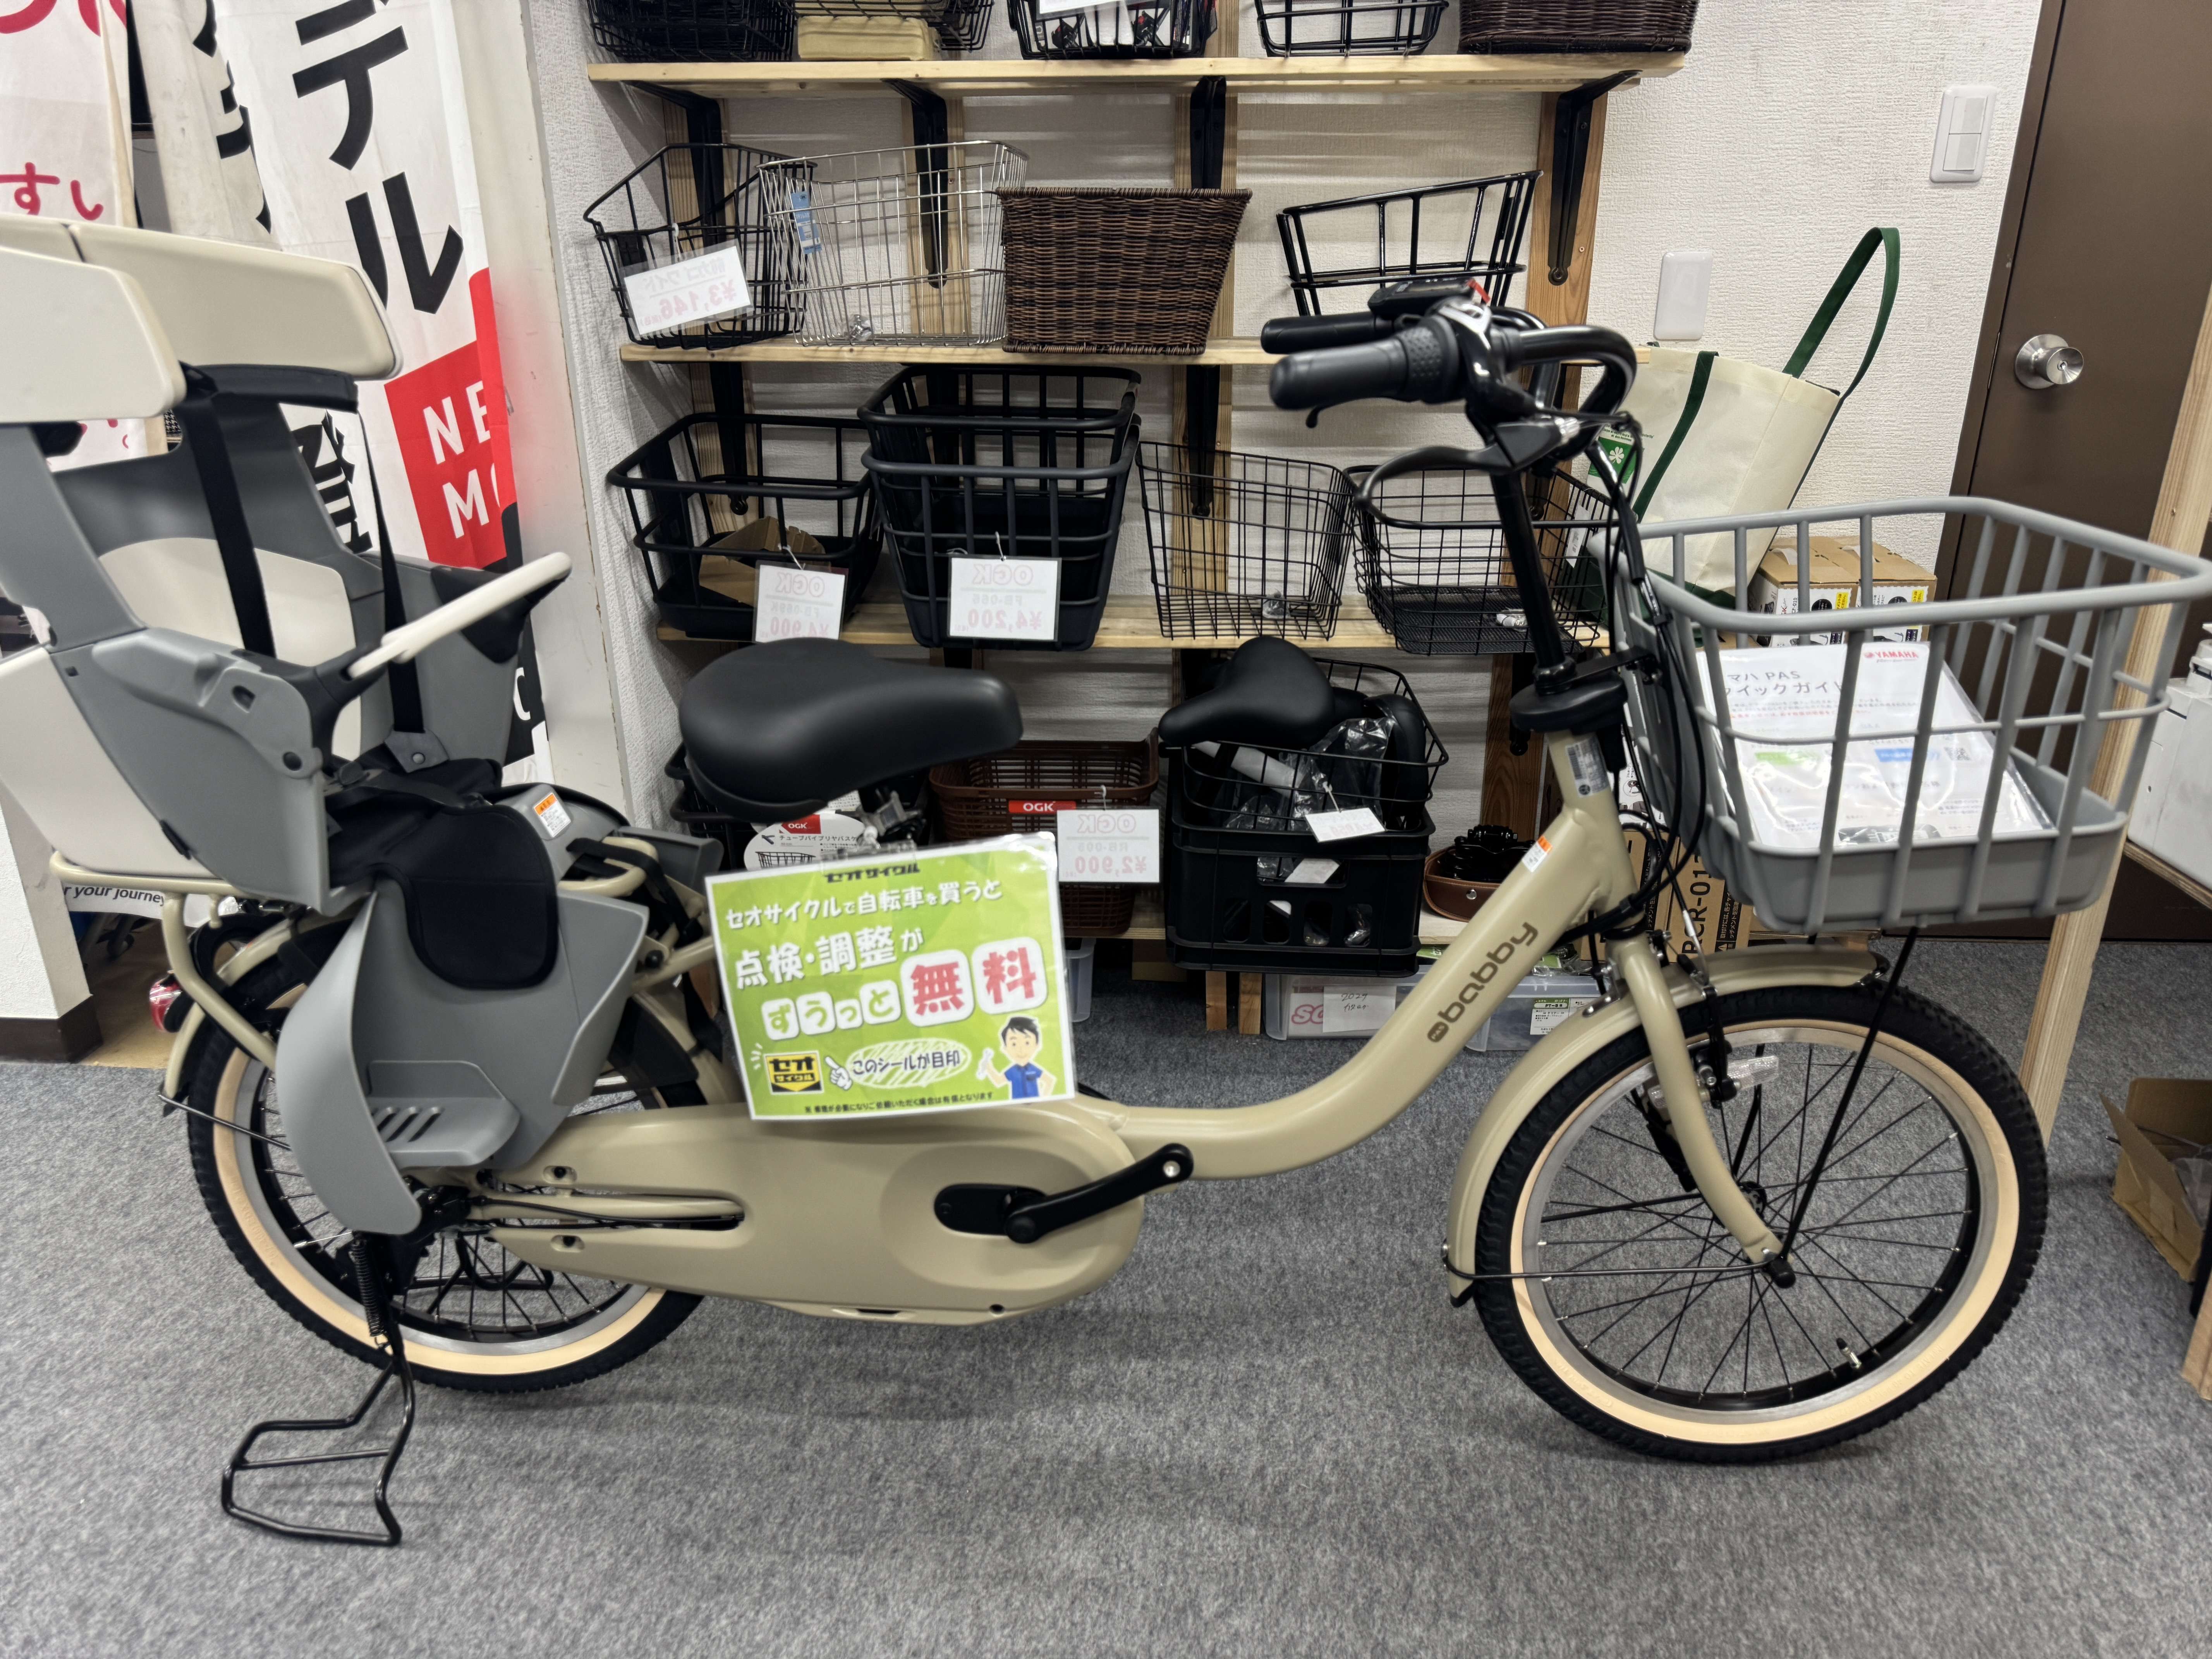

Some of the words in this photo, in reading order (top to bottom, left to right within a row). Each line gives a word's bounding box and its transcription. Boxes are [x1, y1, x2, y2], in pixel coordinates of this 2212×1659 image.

[422, 380, 491, 465] NE
[1875, 651, 1919, 659] YAMAHA
[1728, 672, 1759, 682] マハ
[1766, 670, 1801, 680] PAS
[1022, 801, 1054, 813] OGK
[824, 862, 920, 883] セオサイクル
[74, 886, 113, 899] your
[726, 879, 1003, 931] セオサイクルで自転車を買うと
[734, 924, 925, 990] 点検・調整が
[767, 984, 895, 1036] ずうっと
[910, 946, 1037, 1017] 無料
[769, 1056, 814, 1073] セオ
[852, 1049, 961, 1075] このシールが目印
[775, 1074, 815, 1083] サイクル
